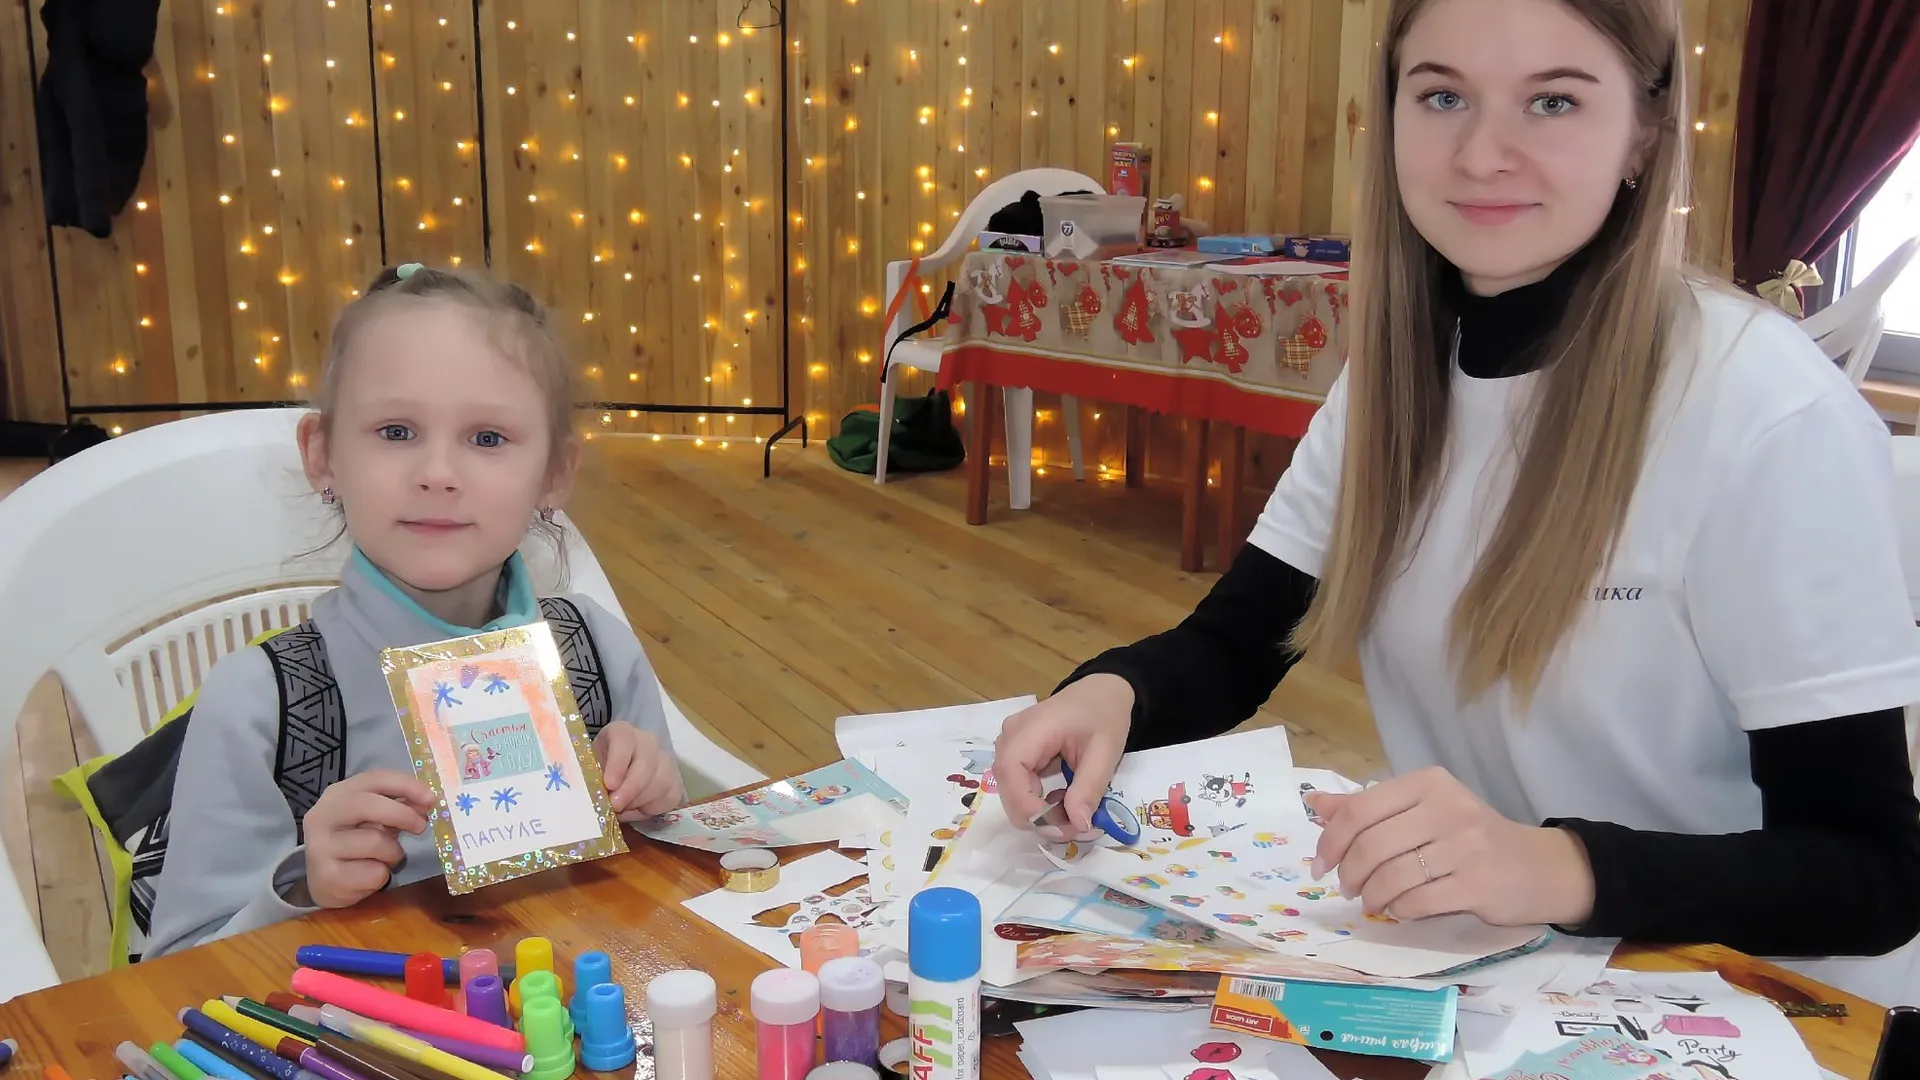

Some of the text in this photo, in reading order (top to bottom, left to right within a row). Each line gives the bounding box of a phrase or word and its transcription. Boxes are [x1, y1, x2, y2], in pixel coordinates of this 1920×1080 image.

[1594, 586, 1643, 601] ика
[462, 818, 547, 850] ПАПУЛЕ
[955, 997, 965, 1039] cardboard
[912, 1023, 934, 1080] AFF
[1678, 1038, 1742, 1062] Party
